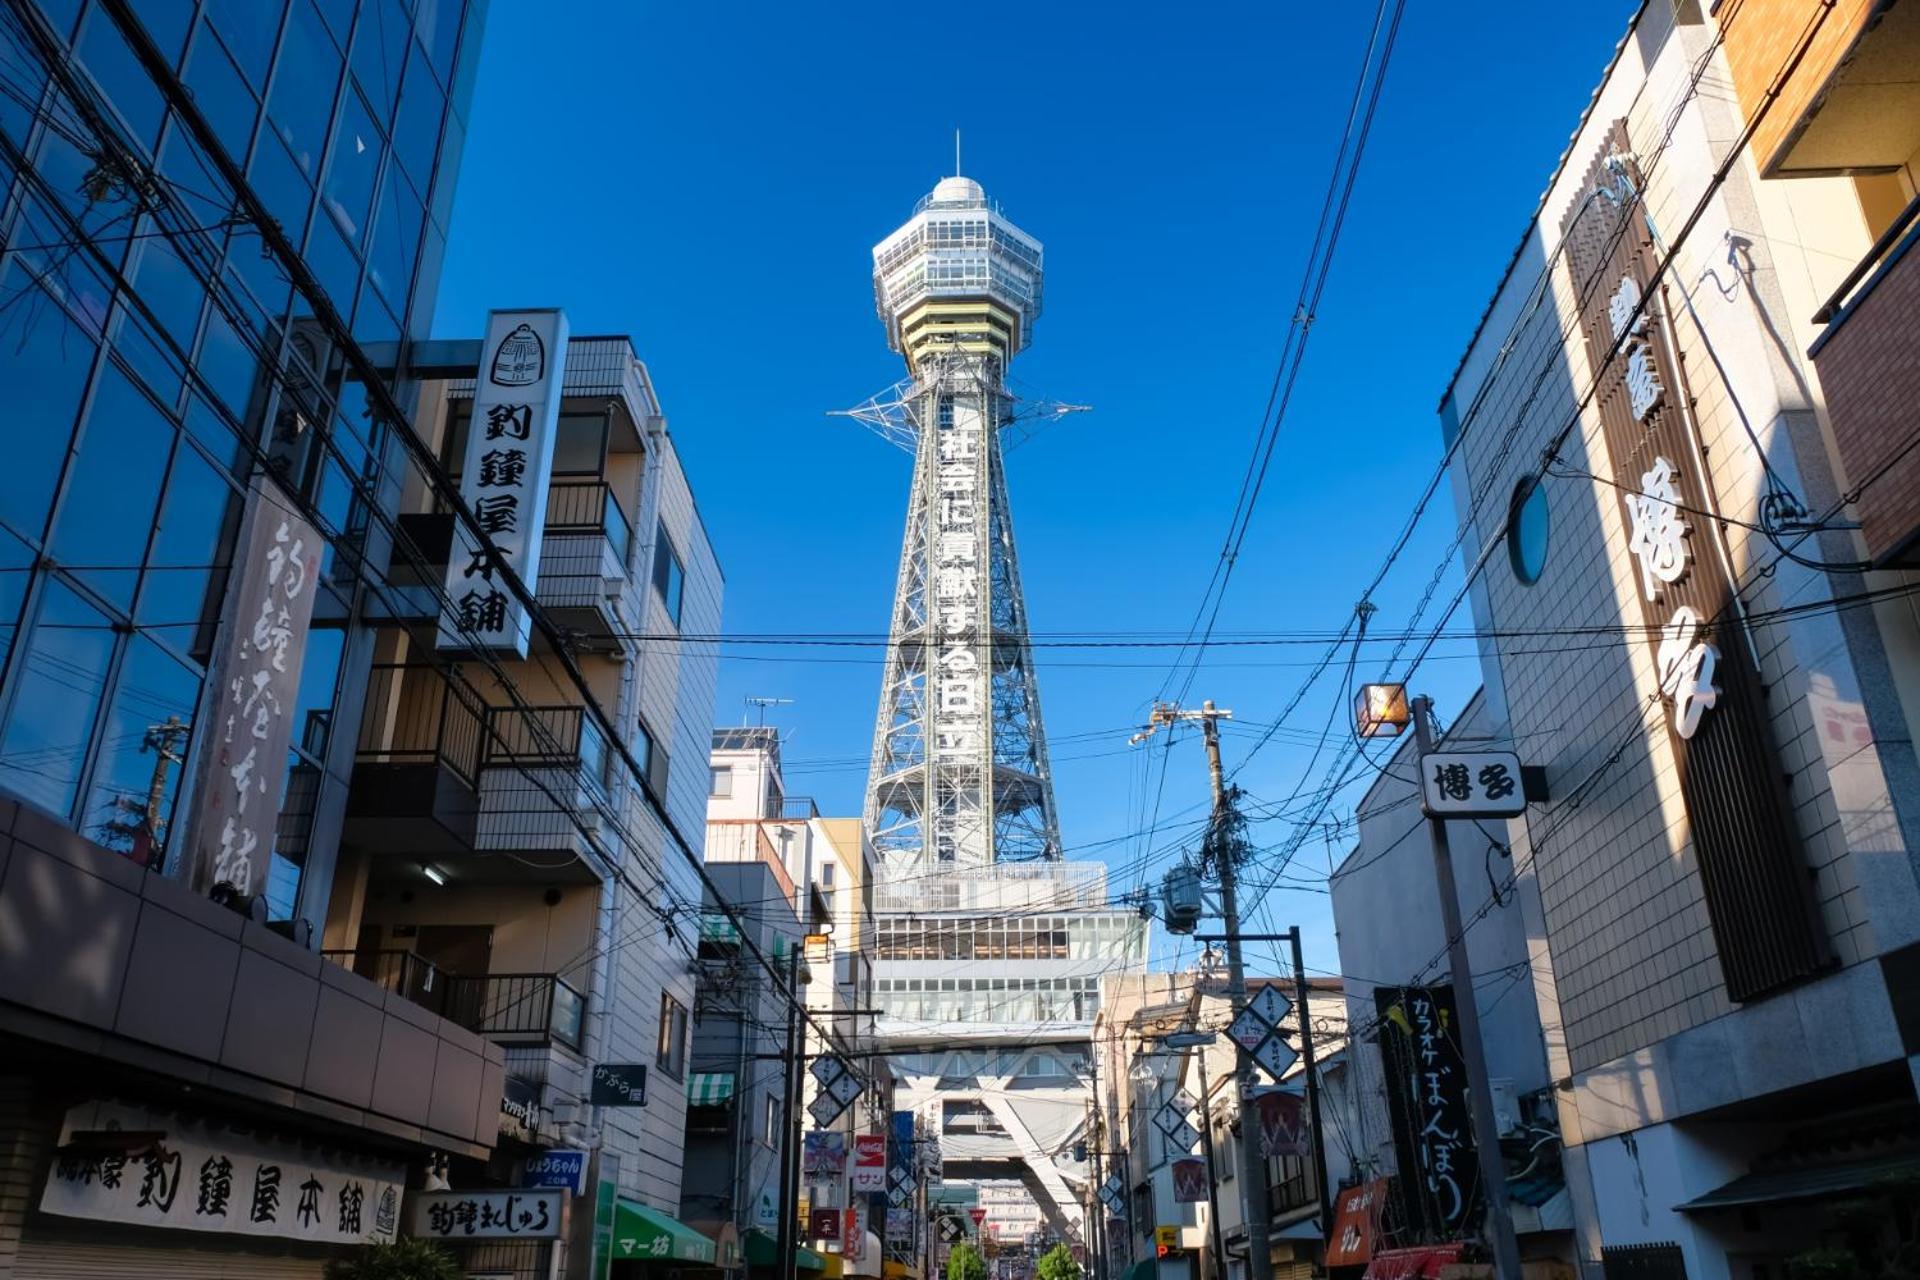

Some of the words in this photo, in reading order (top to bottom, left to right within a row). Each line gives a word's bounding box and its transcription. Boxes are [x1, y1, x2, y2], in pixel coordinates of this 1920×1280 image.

[457, 403, 532, 635] 釣鐘屋本舗
[937, 431, 981, 756] 社会に貢献する日立
[1433, 762, 1514, 802] 博多
[1412, 998, 1439, 1066] カラオケ
[595, 1066, 643, 1101] かぶら屋
[1411, 1067, 1462, 1220] ぼんぼり
[526, 1158, 579, 1174] しょうちゃん
[428, 1195, 549, 1235] 釣鐘まんじゅう
[619, 1235, 670, 1257] マー坊
